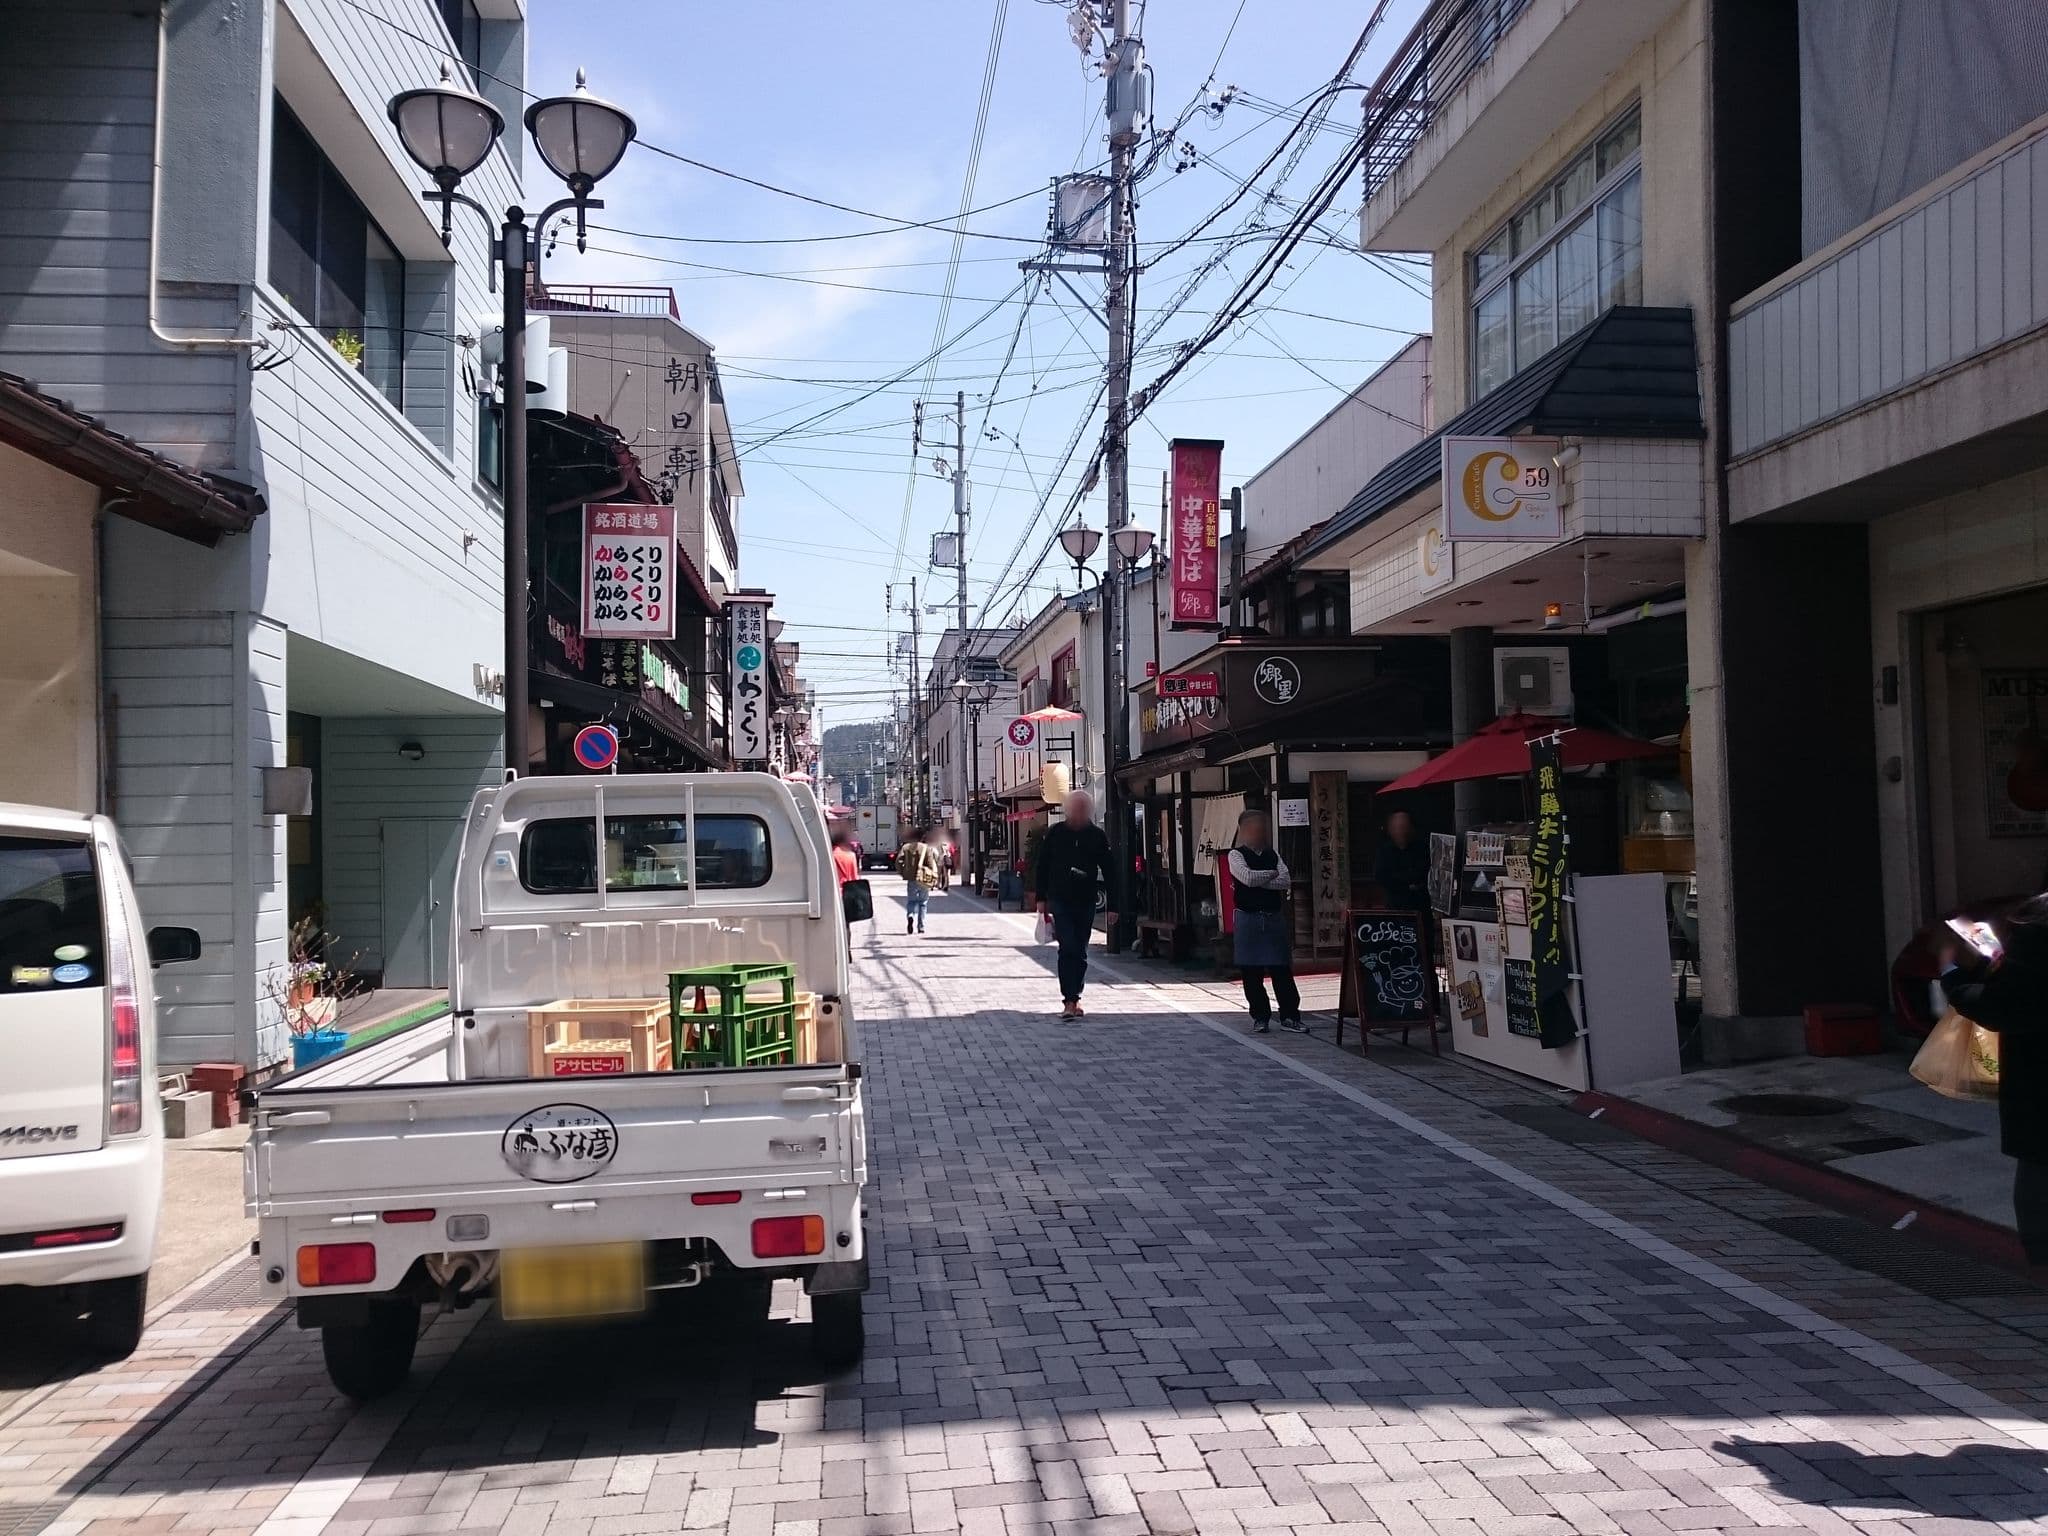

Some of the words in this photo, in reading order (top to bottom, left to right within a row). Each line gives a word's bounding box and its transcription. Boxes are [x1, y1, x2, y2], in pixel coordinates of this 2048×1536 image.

[664, 357, 699, 496] 朝日軒
[1525, 467, 1550, 487] 59
[595, 512, 659, 529] 銘酒道場
[1180, 494, 1204, 583] 中華そば
[595, 545, 662, 563] からくり
[595, 565, 662, 583] からくり
[595, 585, 661, 602] からくり
[594, 603, 661, 621] からくり
[737, 606, 749, 644] 食事処
[750, 606, 762, 644] 地酒処
[554, 1058, 624, 1072] アサヒビール
[0, 1125, 78, 1140] MOVE
